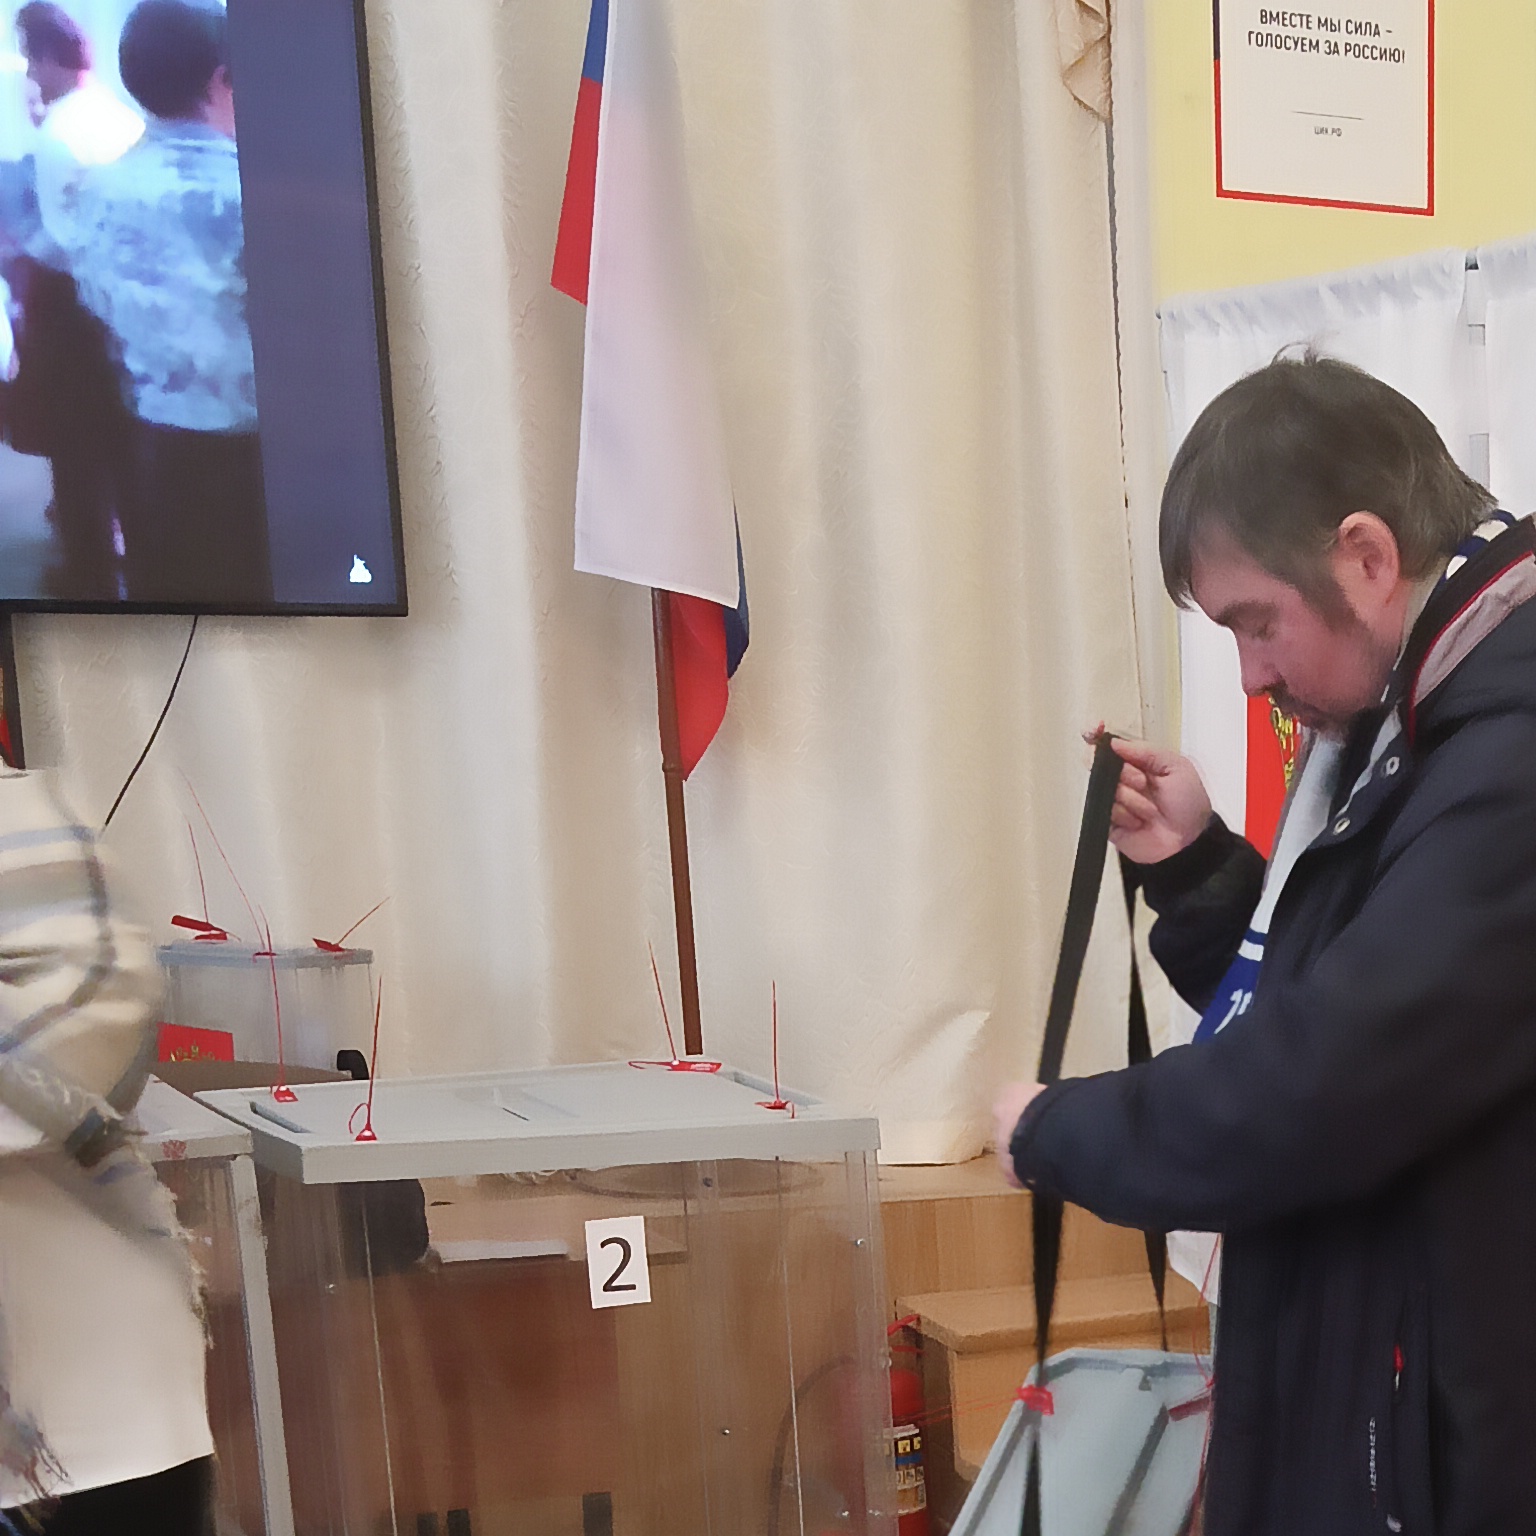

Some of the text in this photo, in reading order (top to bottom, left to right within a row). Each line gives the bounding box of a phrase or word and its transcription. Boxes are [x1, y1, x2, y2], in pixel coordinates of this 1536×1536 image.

[1260, 8, 1313, 31] ВМЕСТЕ
[1317, 16, 1341, 33] МЫ
[1345, 18, 1381, 38] СИЛА
[1247, 30, 1405, 64] ГОЛОСУЕМ ЗА РОССИЮ!
[600, 1236, 637, 1292] 2
